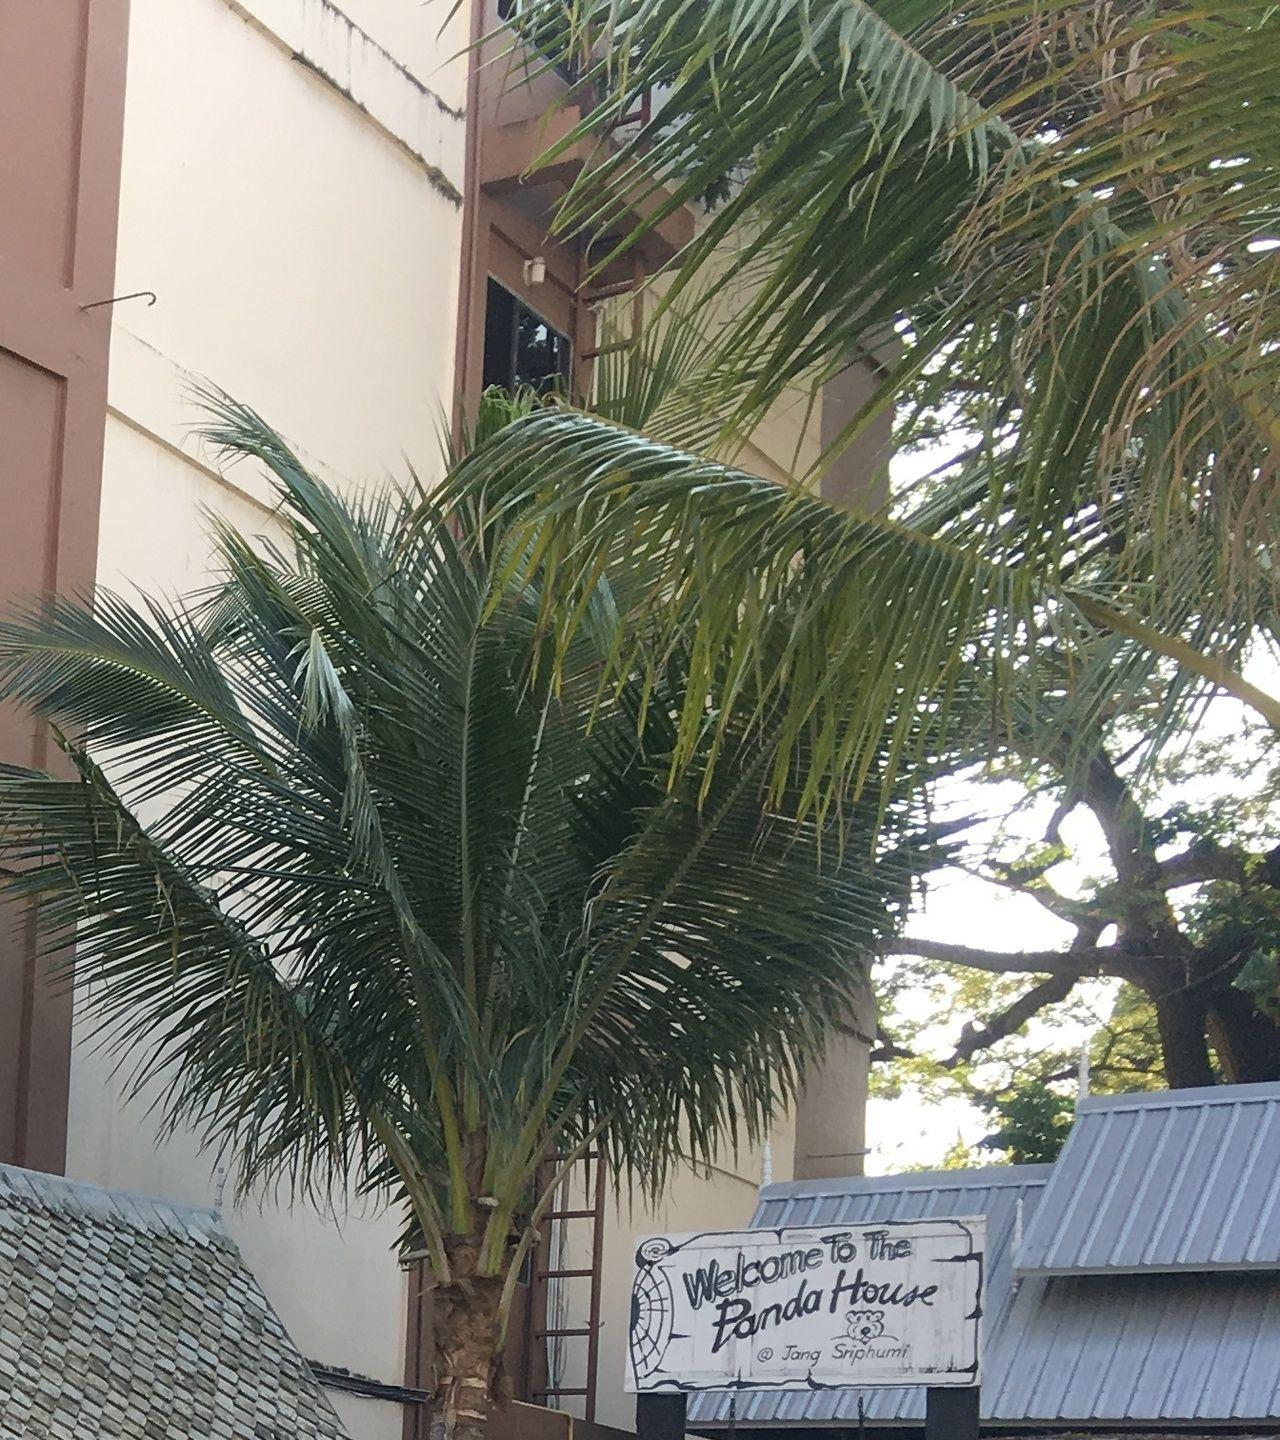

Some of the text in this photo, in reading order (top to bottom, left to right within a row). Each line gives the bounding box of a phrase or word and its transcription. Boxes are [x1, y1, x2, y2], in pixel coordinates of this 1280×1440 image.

[682, 1230, 912, 1311] Welcome To The
[711, 1267, 939, 1354] Panda House
[756, 1342, 912, 1367] @ Jang Sriphumi
